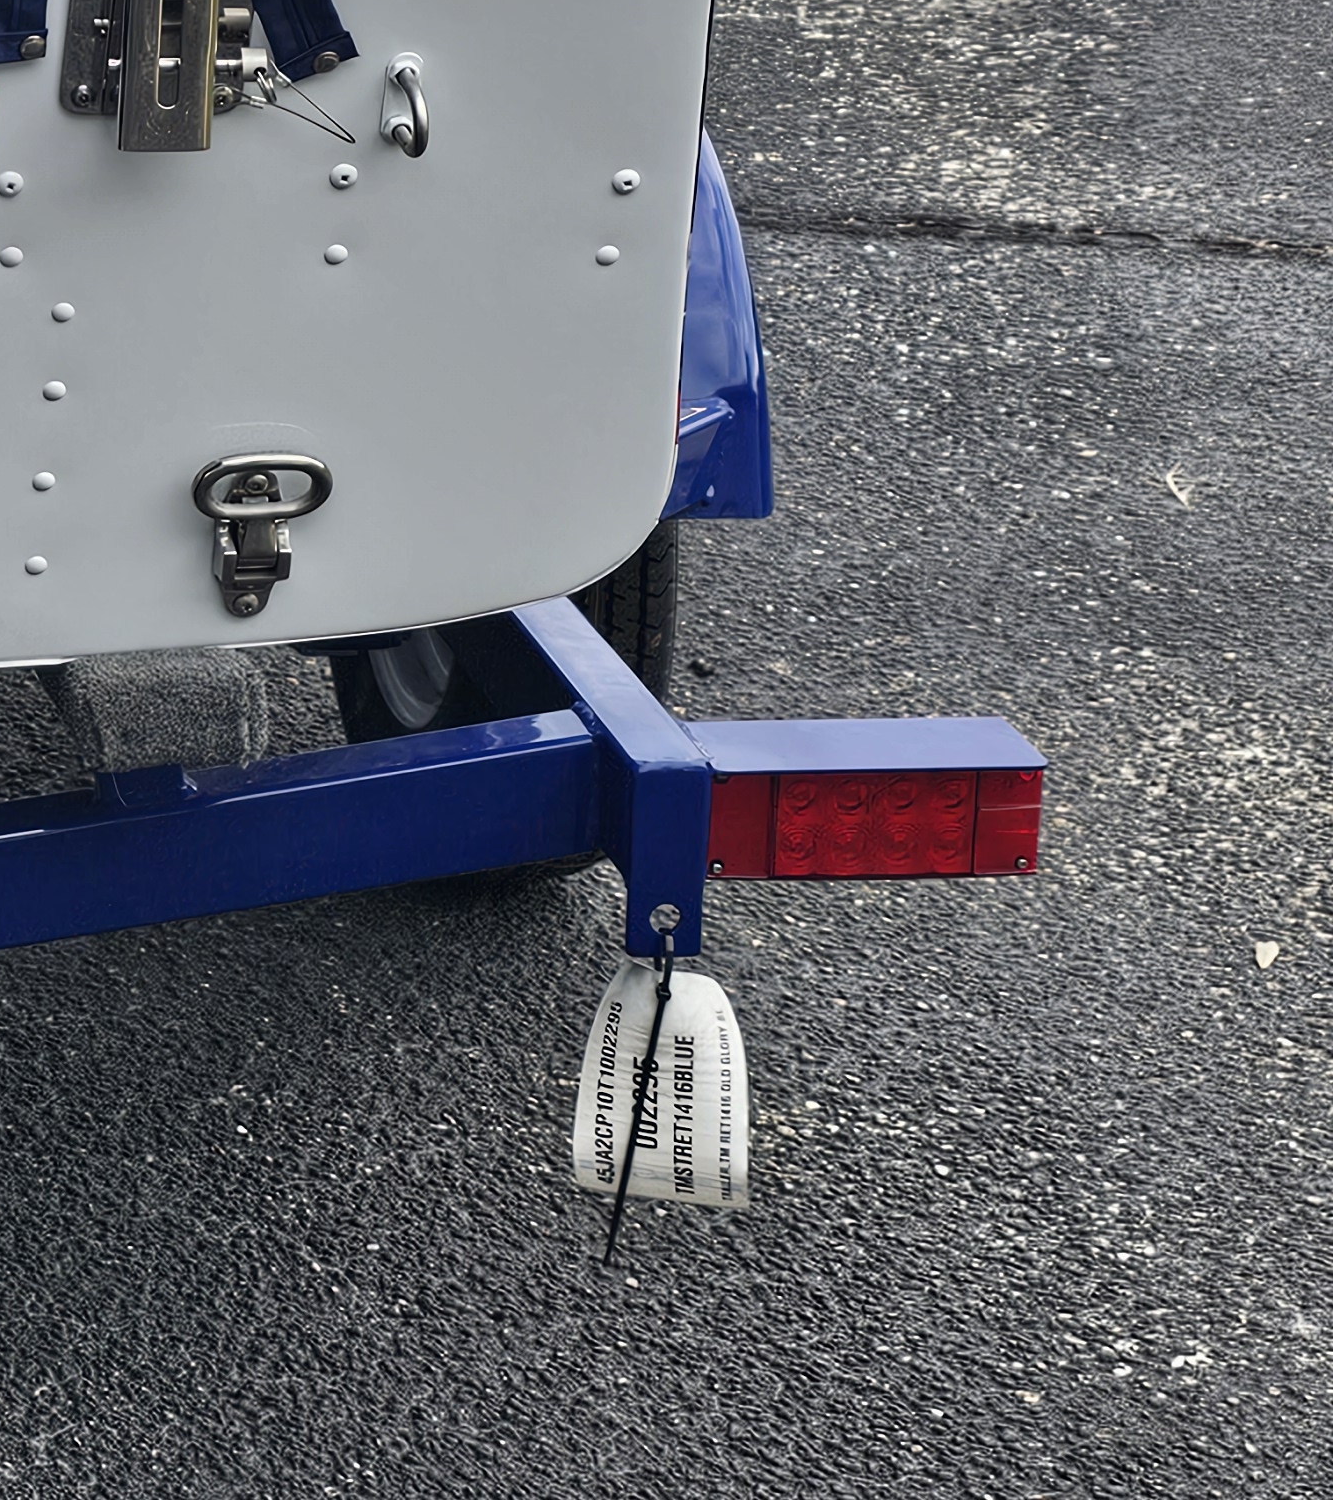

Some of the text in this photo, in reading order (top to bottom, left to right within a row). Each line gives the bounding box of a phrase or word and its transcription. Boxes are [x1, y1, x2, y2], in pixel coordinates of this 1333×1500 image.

[717, 1026, 731, 1065] GLORY
[719, 1069, 732, 1092] OLD
[672, 1034, 696, 1195] TMSTRET1416BLUE
